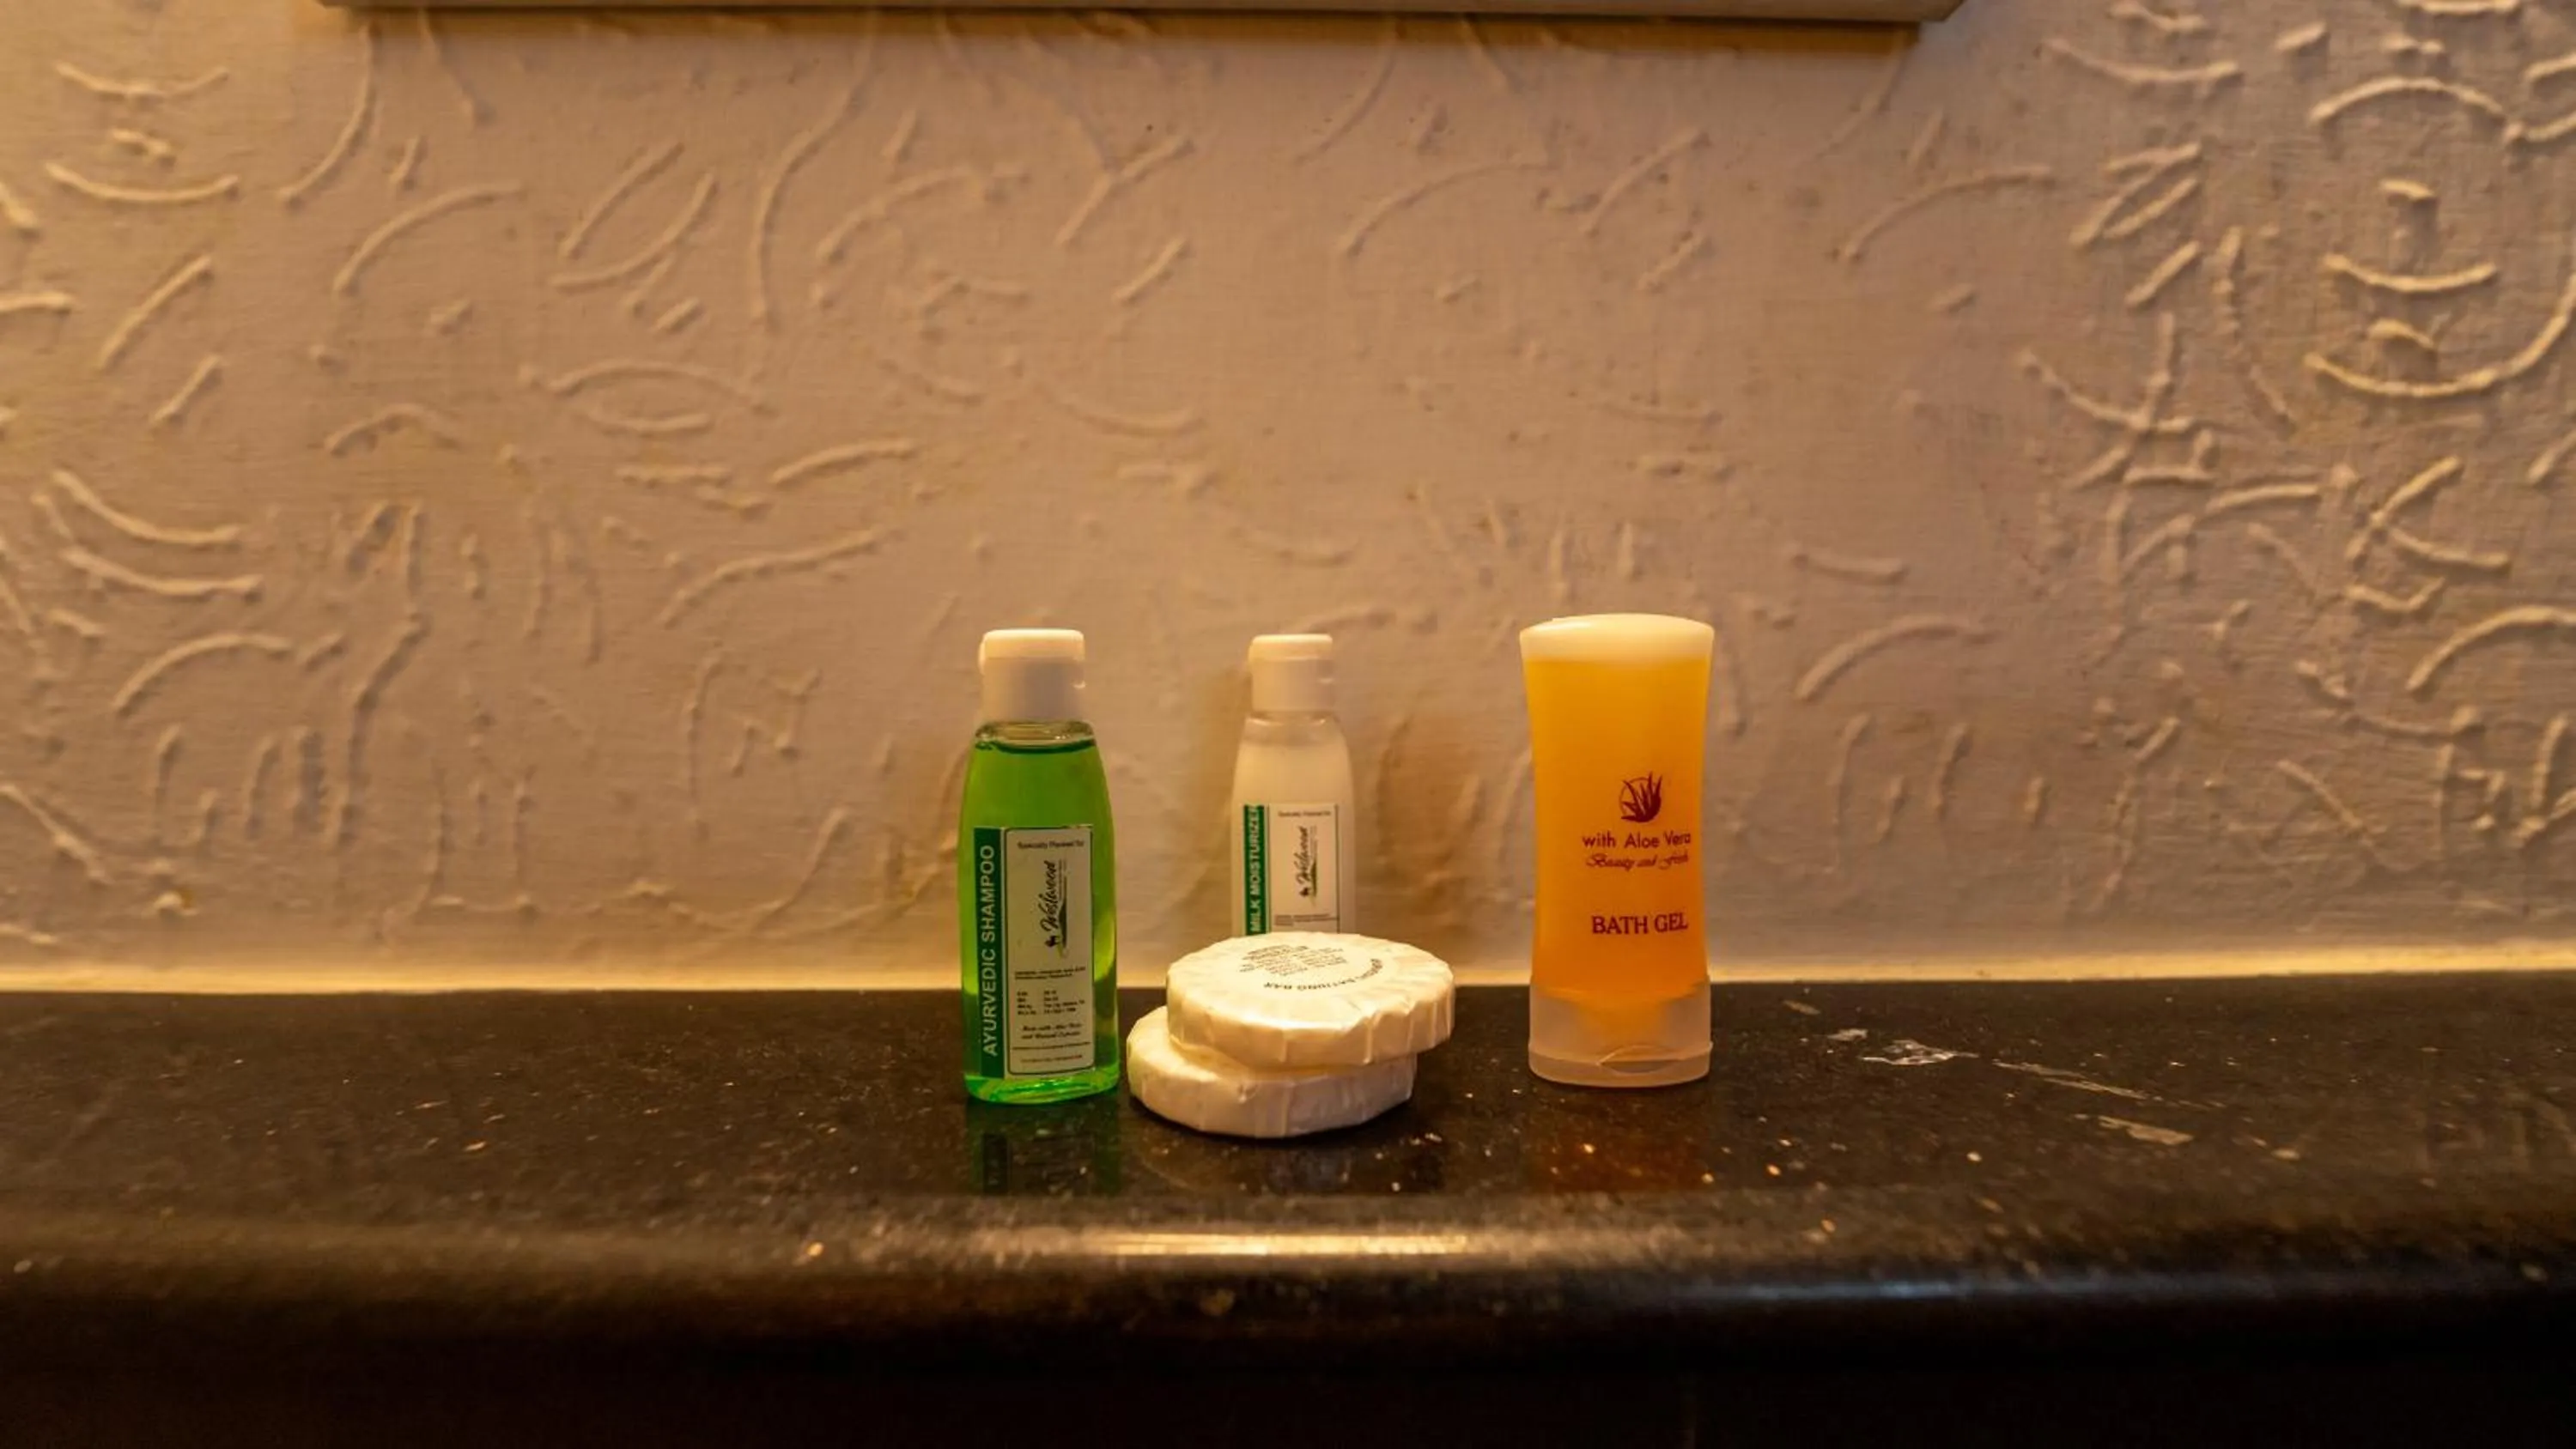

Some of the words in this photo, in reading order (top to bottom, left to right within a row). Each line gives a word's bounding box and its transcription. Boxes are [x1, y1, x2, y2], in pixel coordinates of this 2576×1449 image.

[1582, 829, 1617, 848] with
[1624, 831, 1660, 848] Aloe
[1664, 831, 1692, 846] Vera
[980, 845, 996, 943] SHAMPOO
[1249, 896, 1261, 931] MILK
[1592, 915, 1648, 935] BATH
[1654, 912, 1688, 933] GEL
[981, 949, 998, 1057] AYURVEDIC
